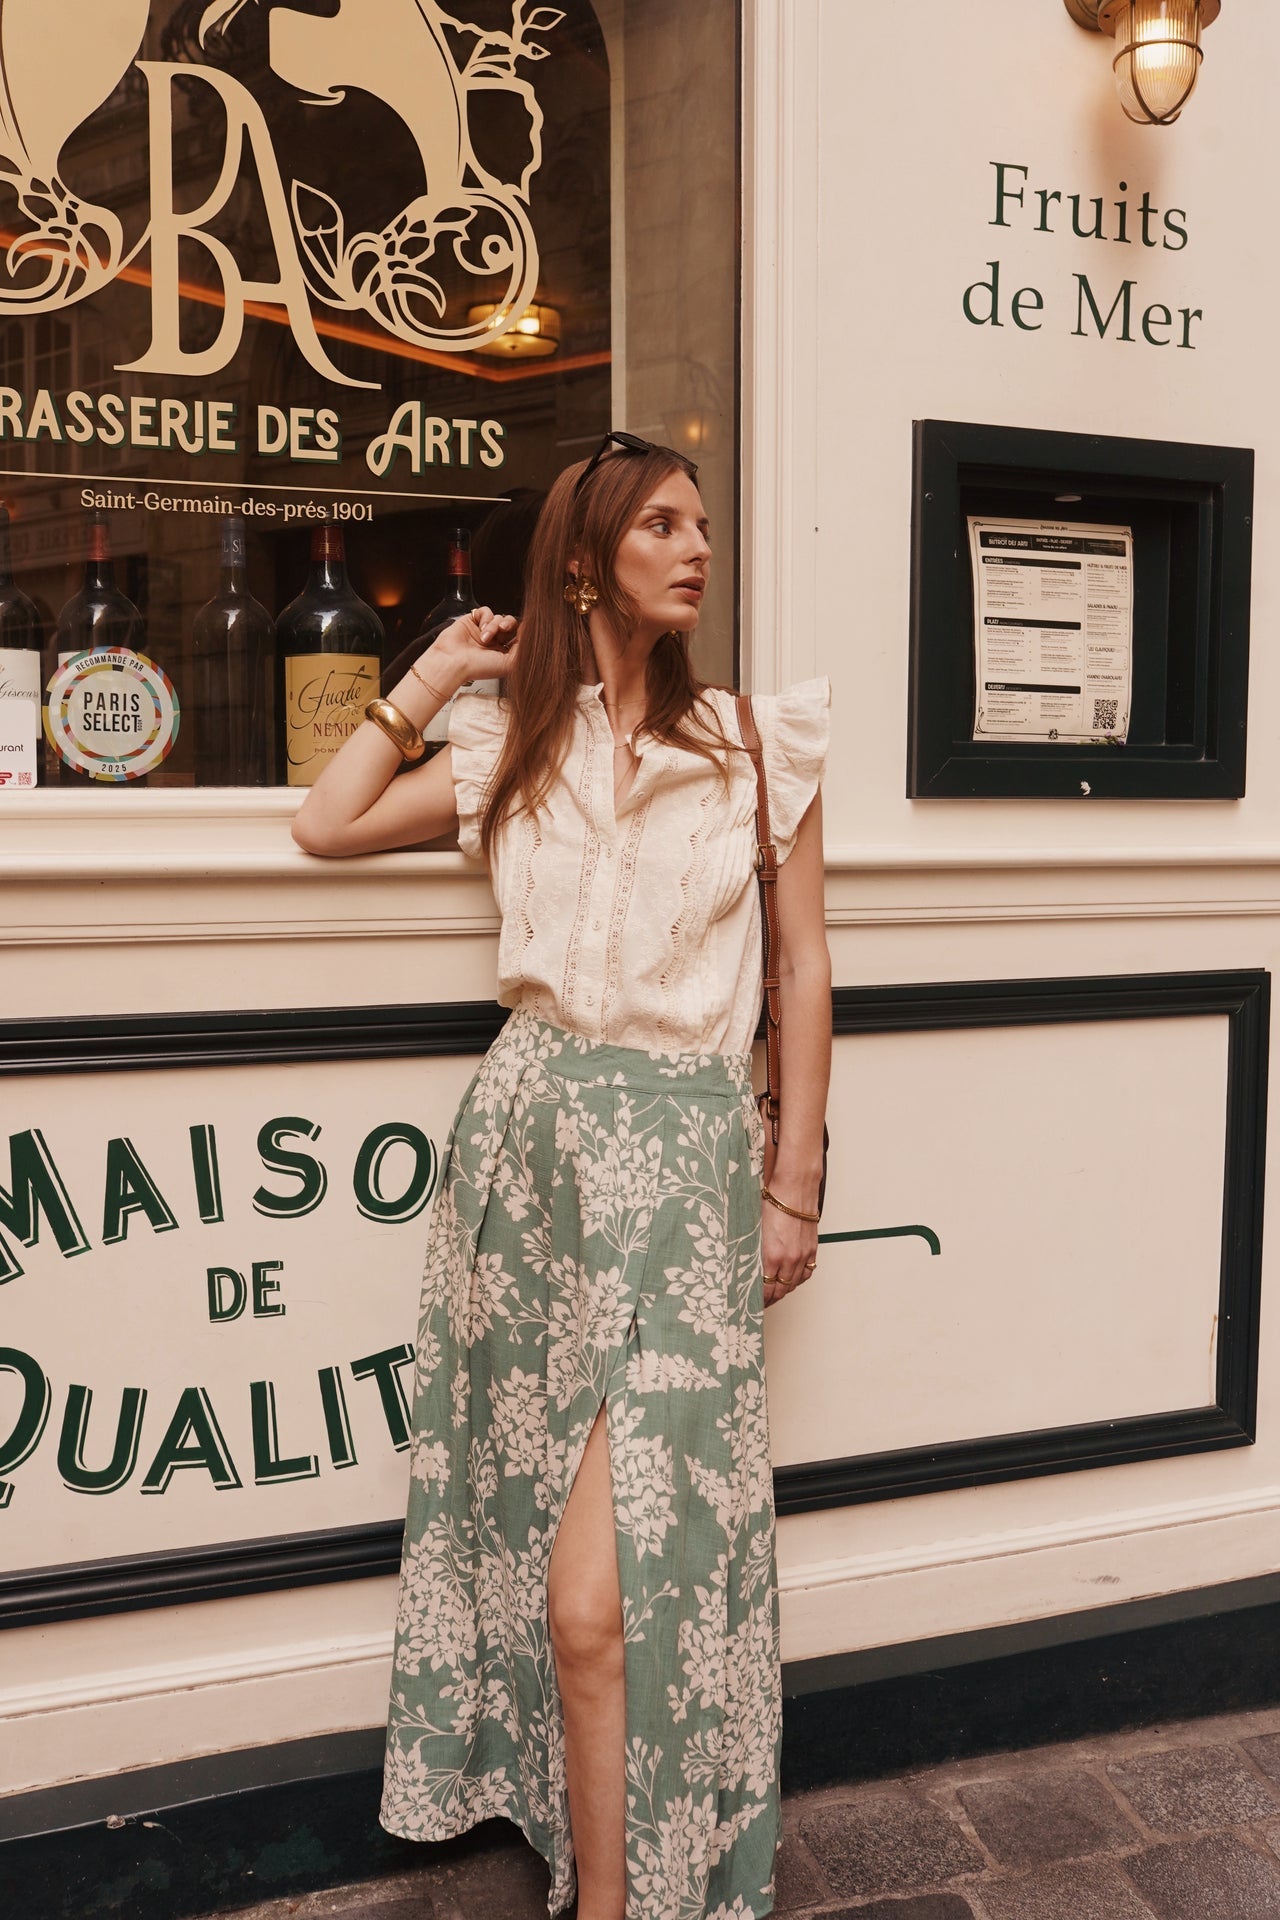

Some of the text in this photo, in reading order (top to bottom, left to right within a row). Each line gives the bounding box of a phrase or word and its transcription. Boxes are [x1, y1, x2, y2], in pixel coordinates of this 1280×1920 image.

[988, 161, 1189, 251] Fruits
[962, 261, 1203, 350] de Mer
[257, 405, 342, 464] DES
[80, 489, 374, 522] Saint-Germain-des-prés 1901
[75, 656, 144, 672] RECOMMANDÉ PAR
[84, 692, 140, 712] PARIS
[83, 713, 140, 733] SELECT
[101, 763, 127, 773] 2025
[207, 1260, 286, 1323] DE
